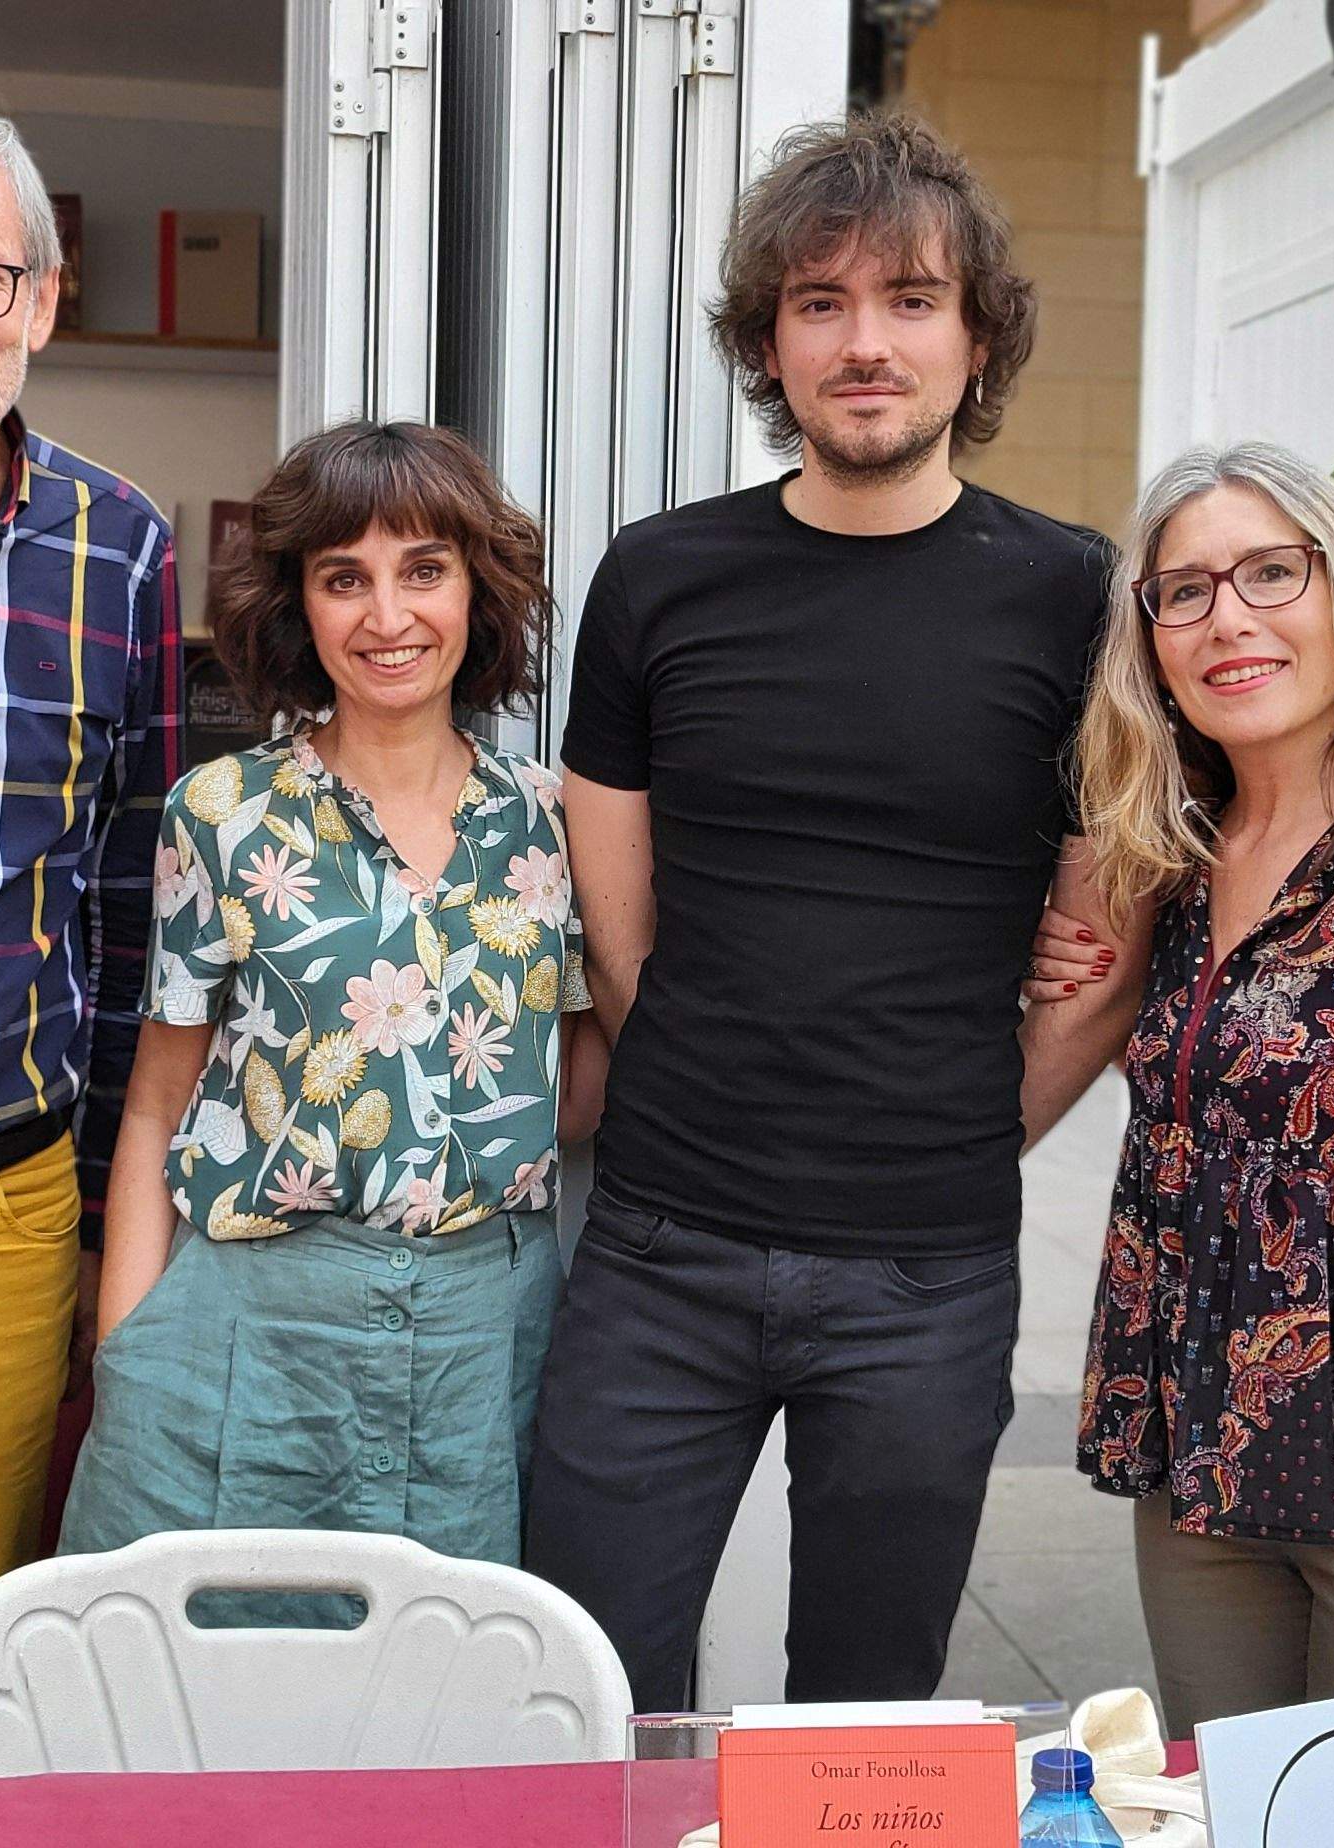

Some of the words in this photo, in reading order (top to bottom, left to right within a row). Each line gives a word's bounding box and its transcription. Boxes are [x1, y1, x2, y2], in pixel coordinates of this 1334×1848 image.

[811, 1761, 861, 1778] Omar
[866, 1759, 947, 1778] Fonollosa
[816, 1803, 863, 1831] Los
[872, 1803, 945, 1831] niños
